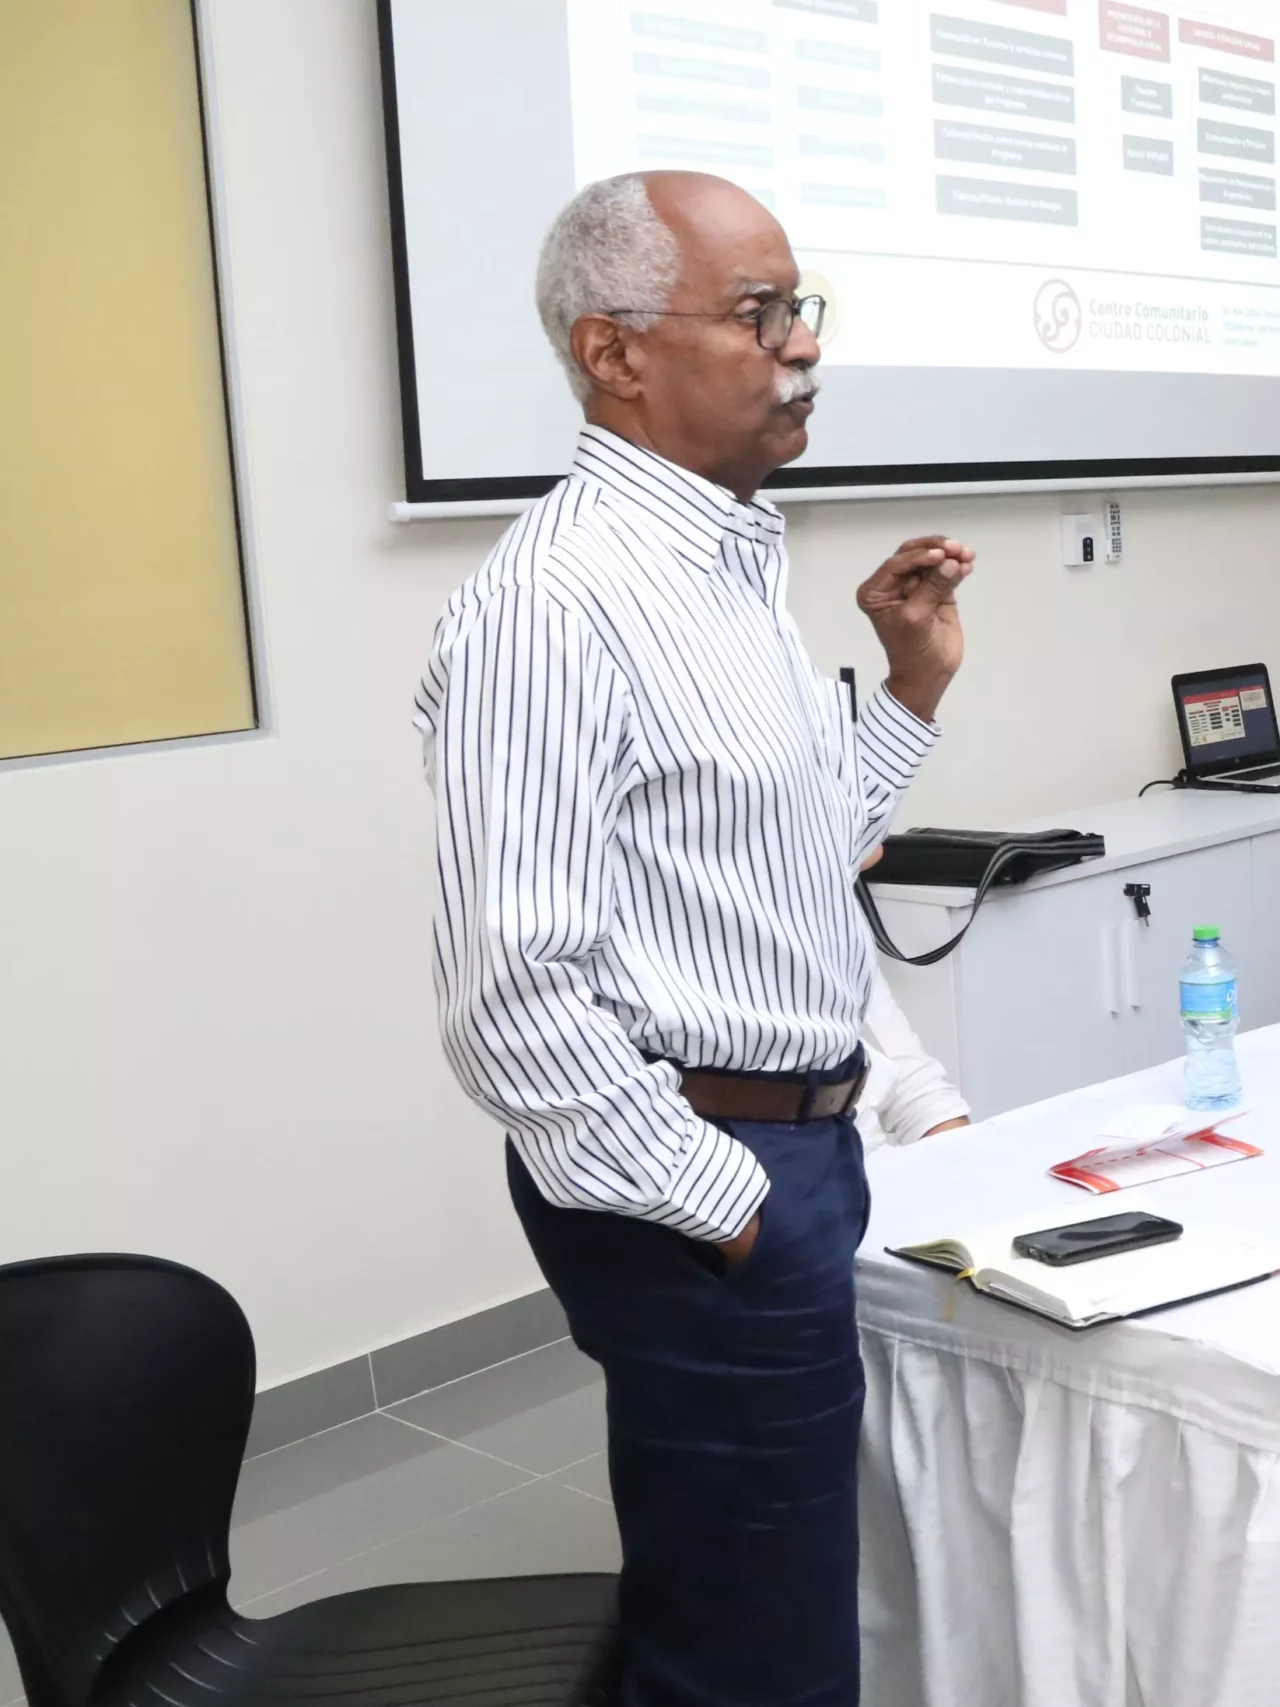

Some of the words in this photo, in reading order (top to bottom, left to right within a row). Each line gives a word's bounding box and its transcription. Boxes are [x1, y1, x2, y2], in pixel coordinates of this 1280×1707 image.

[1089, 299, 1132, 317] Centro
[1135, 301, 1209, 322] Comunitario
[1089, 321, 1142, 341] CIUDAD
[1147, 322, 1212, 344] COLONIAL
